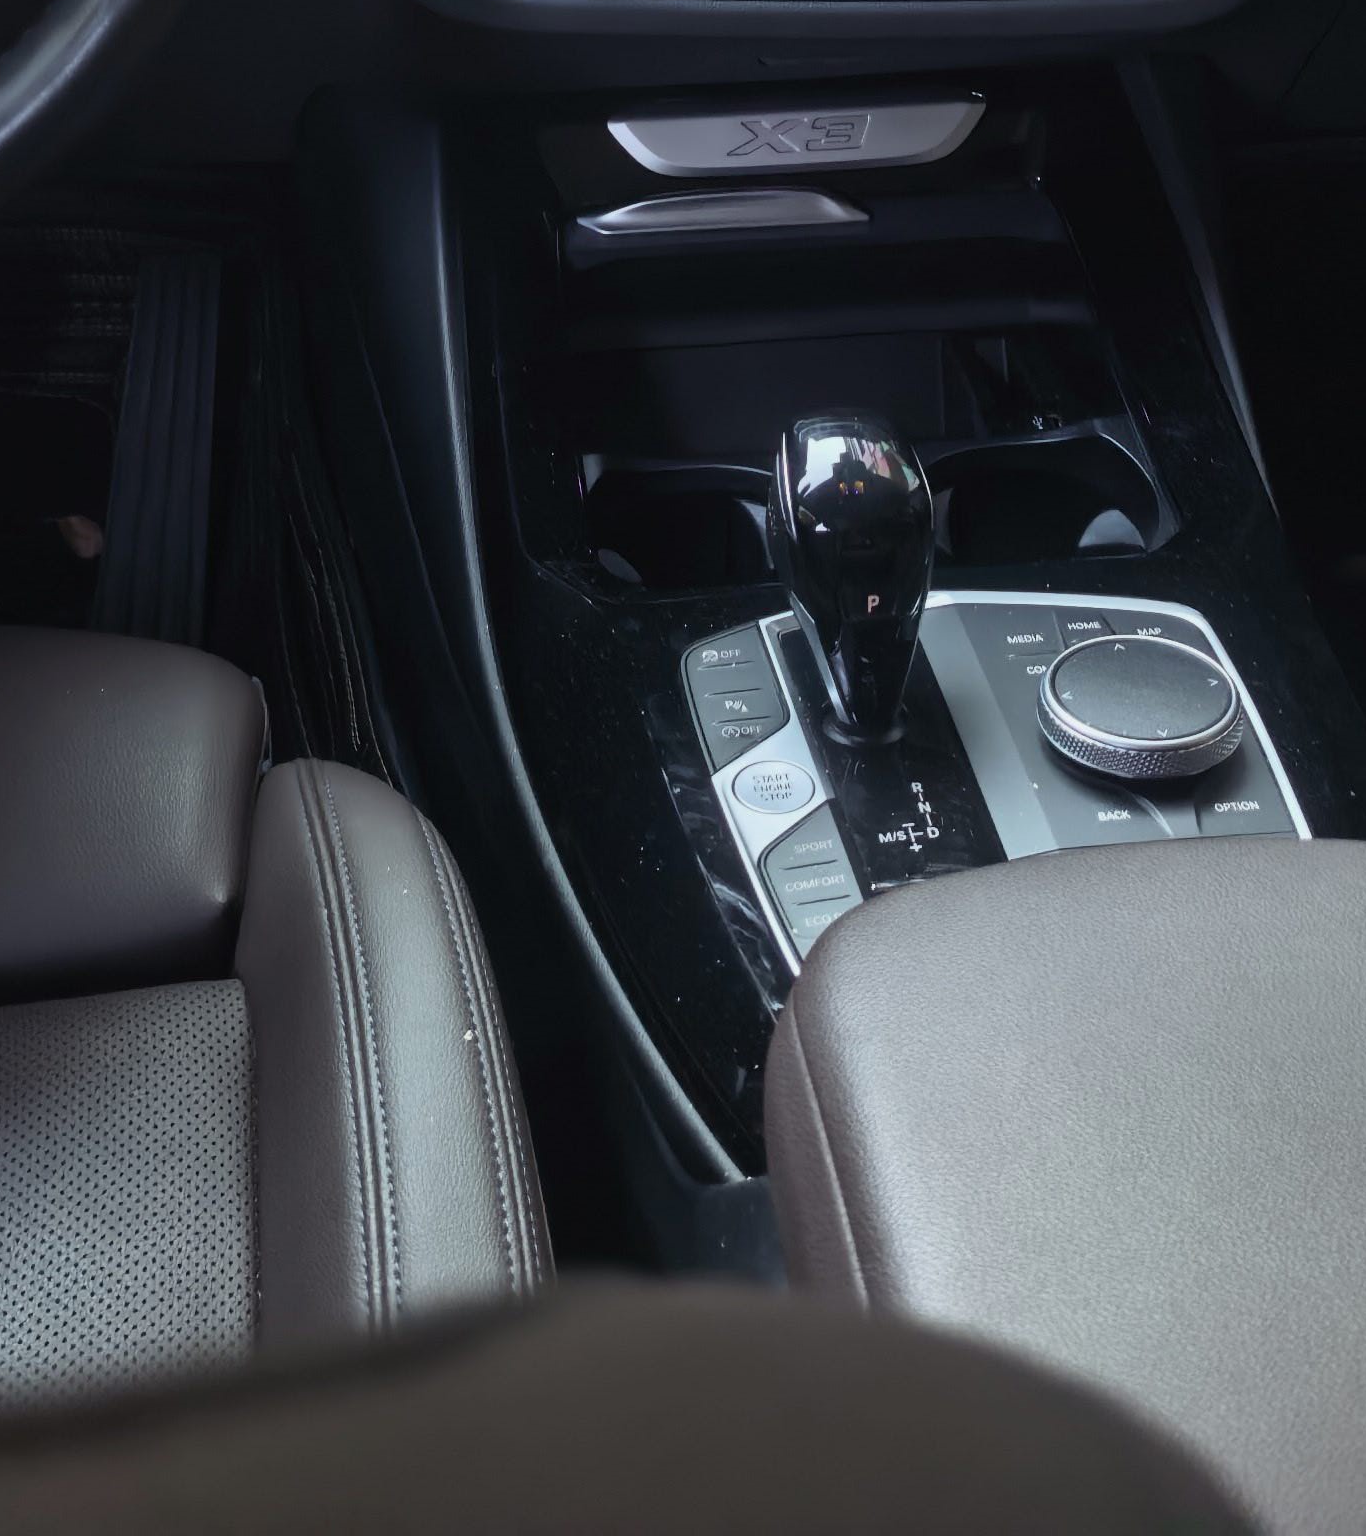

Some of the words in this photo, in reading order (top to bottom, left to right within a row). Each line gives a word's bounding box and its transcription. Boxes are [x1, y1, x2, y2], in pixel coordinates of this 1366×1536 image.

[727, 113, 871, 156] X3
[867, 595, 879, 612] P
[1067, 621, 1101, 631] HOME
[1137, 627, 1161, 636] MAP
[1007, 633, 1043, 644] MEDIA
[720, 648, 741, 658] OFF
[741, 725, 761, 735] OFF
[752, 774, 791, 784] START
[753, 783, 793, 792] ENGINE
[912, 782, 922, 792] R
[760, 792, 792, 801] STOP
[918, 802, 931, 813] N
[1214, 800, 1259, 812] OPTION
[1098, 809, 1130, 822] BACK
[879, 830, 906, 843] M/S
[928, 827, 939, 838] D
[794, 840, 834, 853] SPORT
[785, 874, 845, 892] COMFORT
[805, 914, 831, 928] ECO
